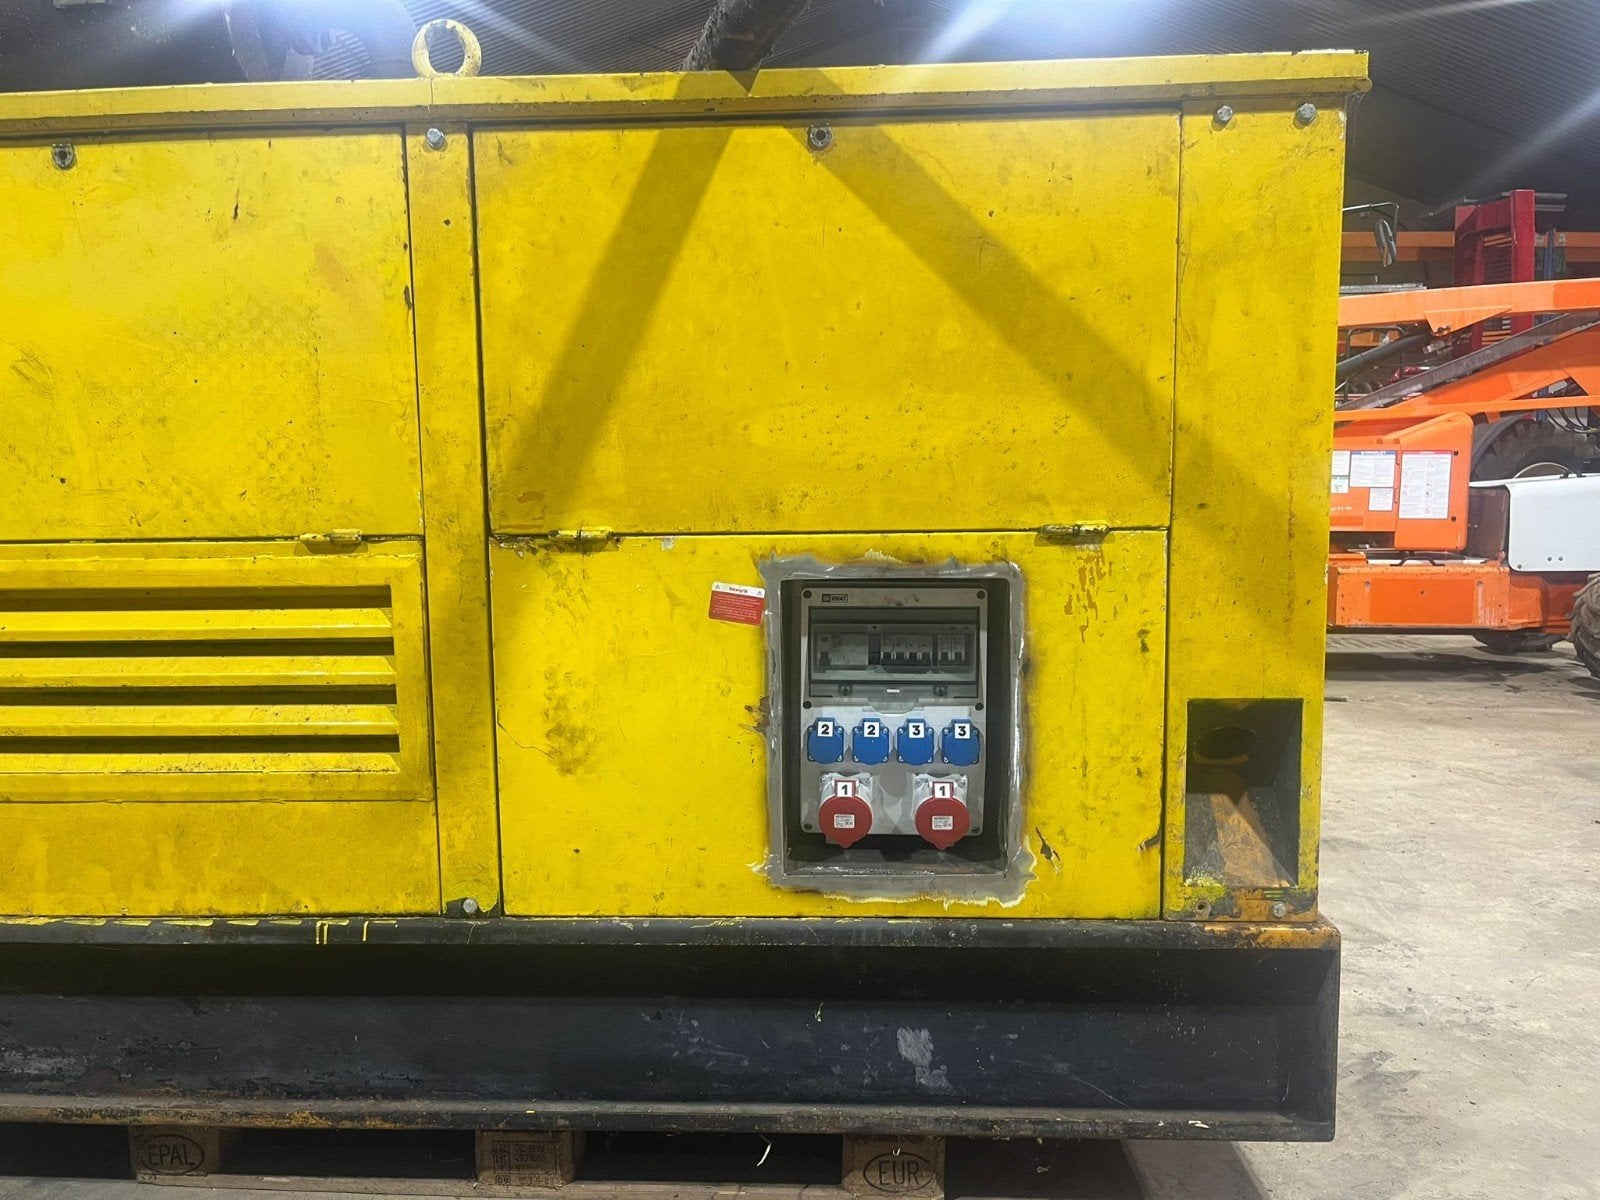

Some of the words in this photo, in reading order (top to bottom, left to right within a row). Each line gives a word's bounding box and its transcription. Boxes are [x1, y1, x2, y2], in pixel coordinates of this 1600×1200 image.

[821, 724, 830, 735] 2
[867, 724, 876, 736] 2
[912, 725, 921, 736] 3
[958, 725, 967, 737] 3
[841, 785, 848, 796] 1
[939, 786, 946, 797] 1
[147, 1144, 195, 1166] EPAL
[878, 1160, 920, 1186] EUR
